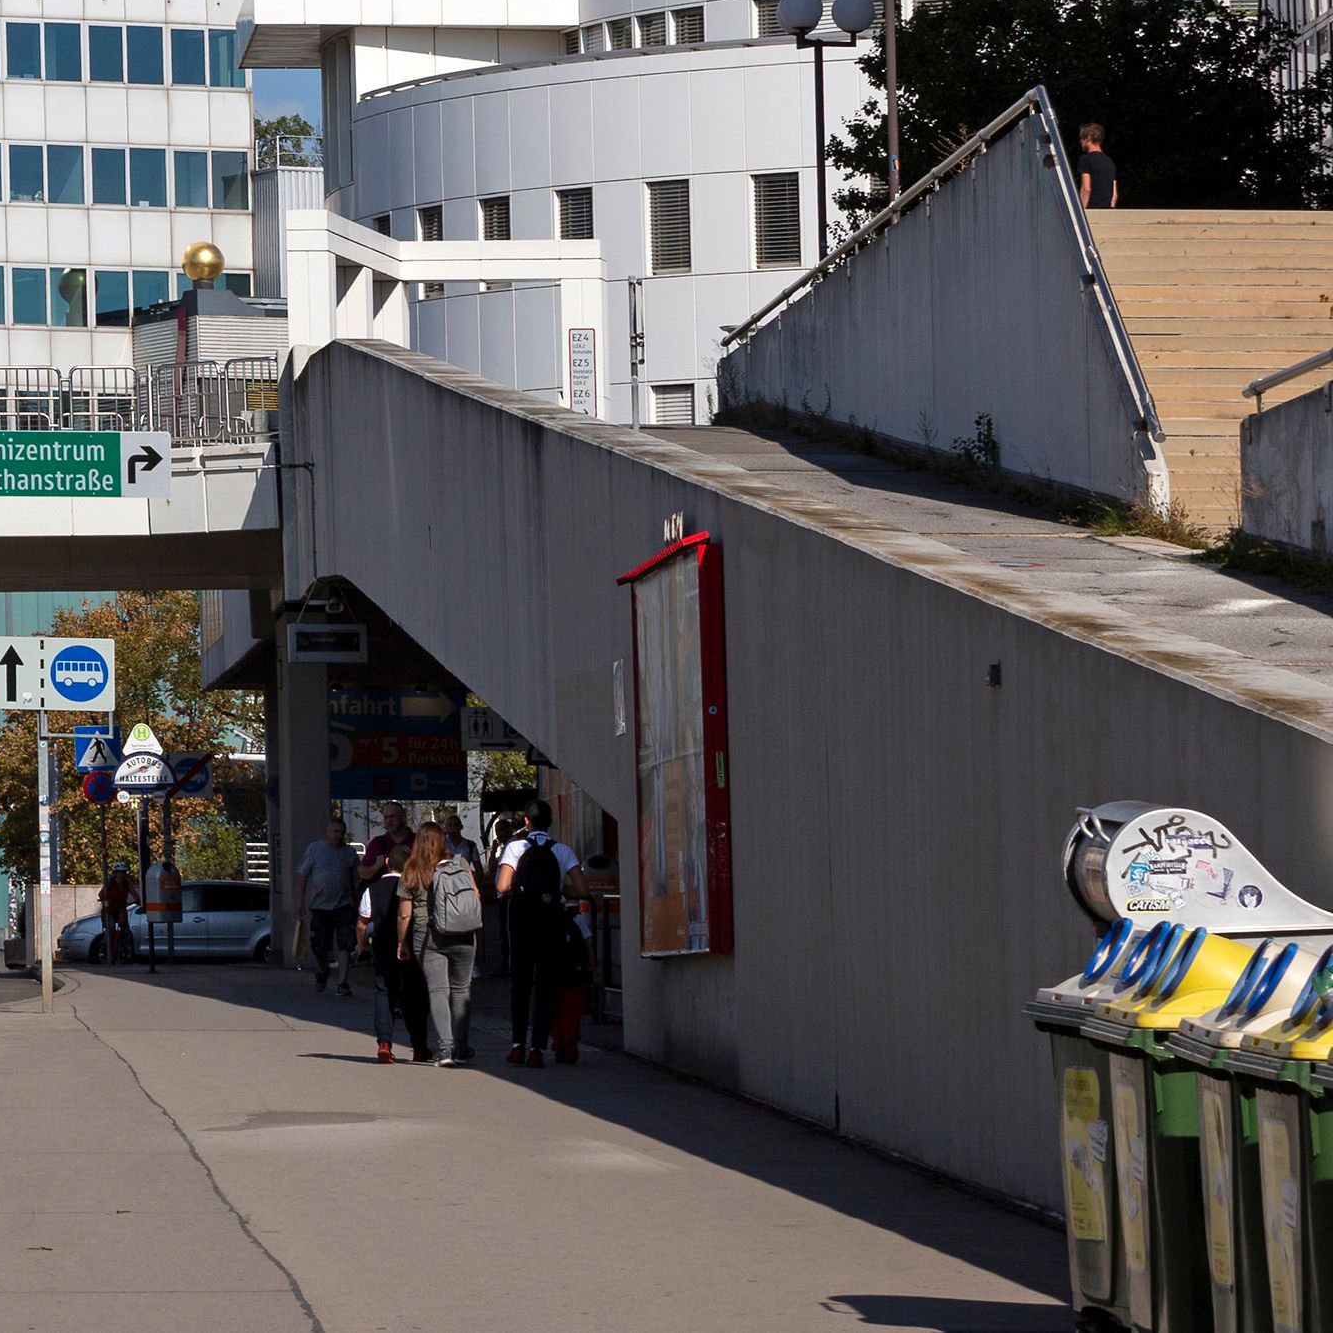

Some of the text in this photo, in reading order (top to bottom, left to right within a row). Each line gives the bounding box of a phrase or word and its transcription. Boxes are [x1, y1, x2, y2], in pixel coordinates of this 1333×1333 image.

[572, 332, 589, 342] EZ 4
[573, 358, 590, 367] EZ 5
[573, 389, 591, 398] EZ 6
[329, 693, 398, 716] nfahrt
[137, 727, 146, 738] H
[126, 757, 164, 770] AUTOBUS
[1127, 899, 1171, 912] CATISM
